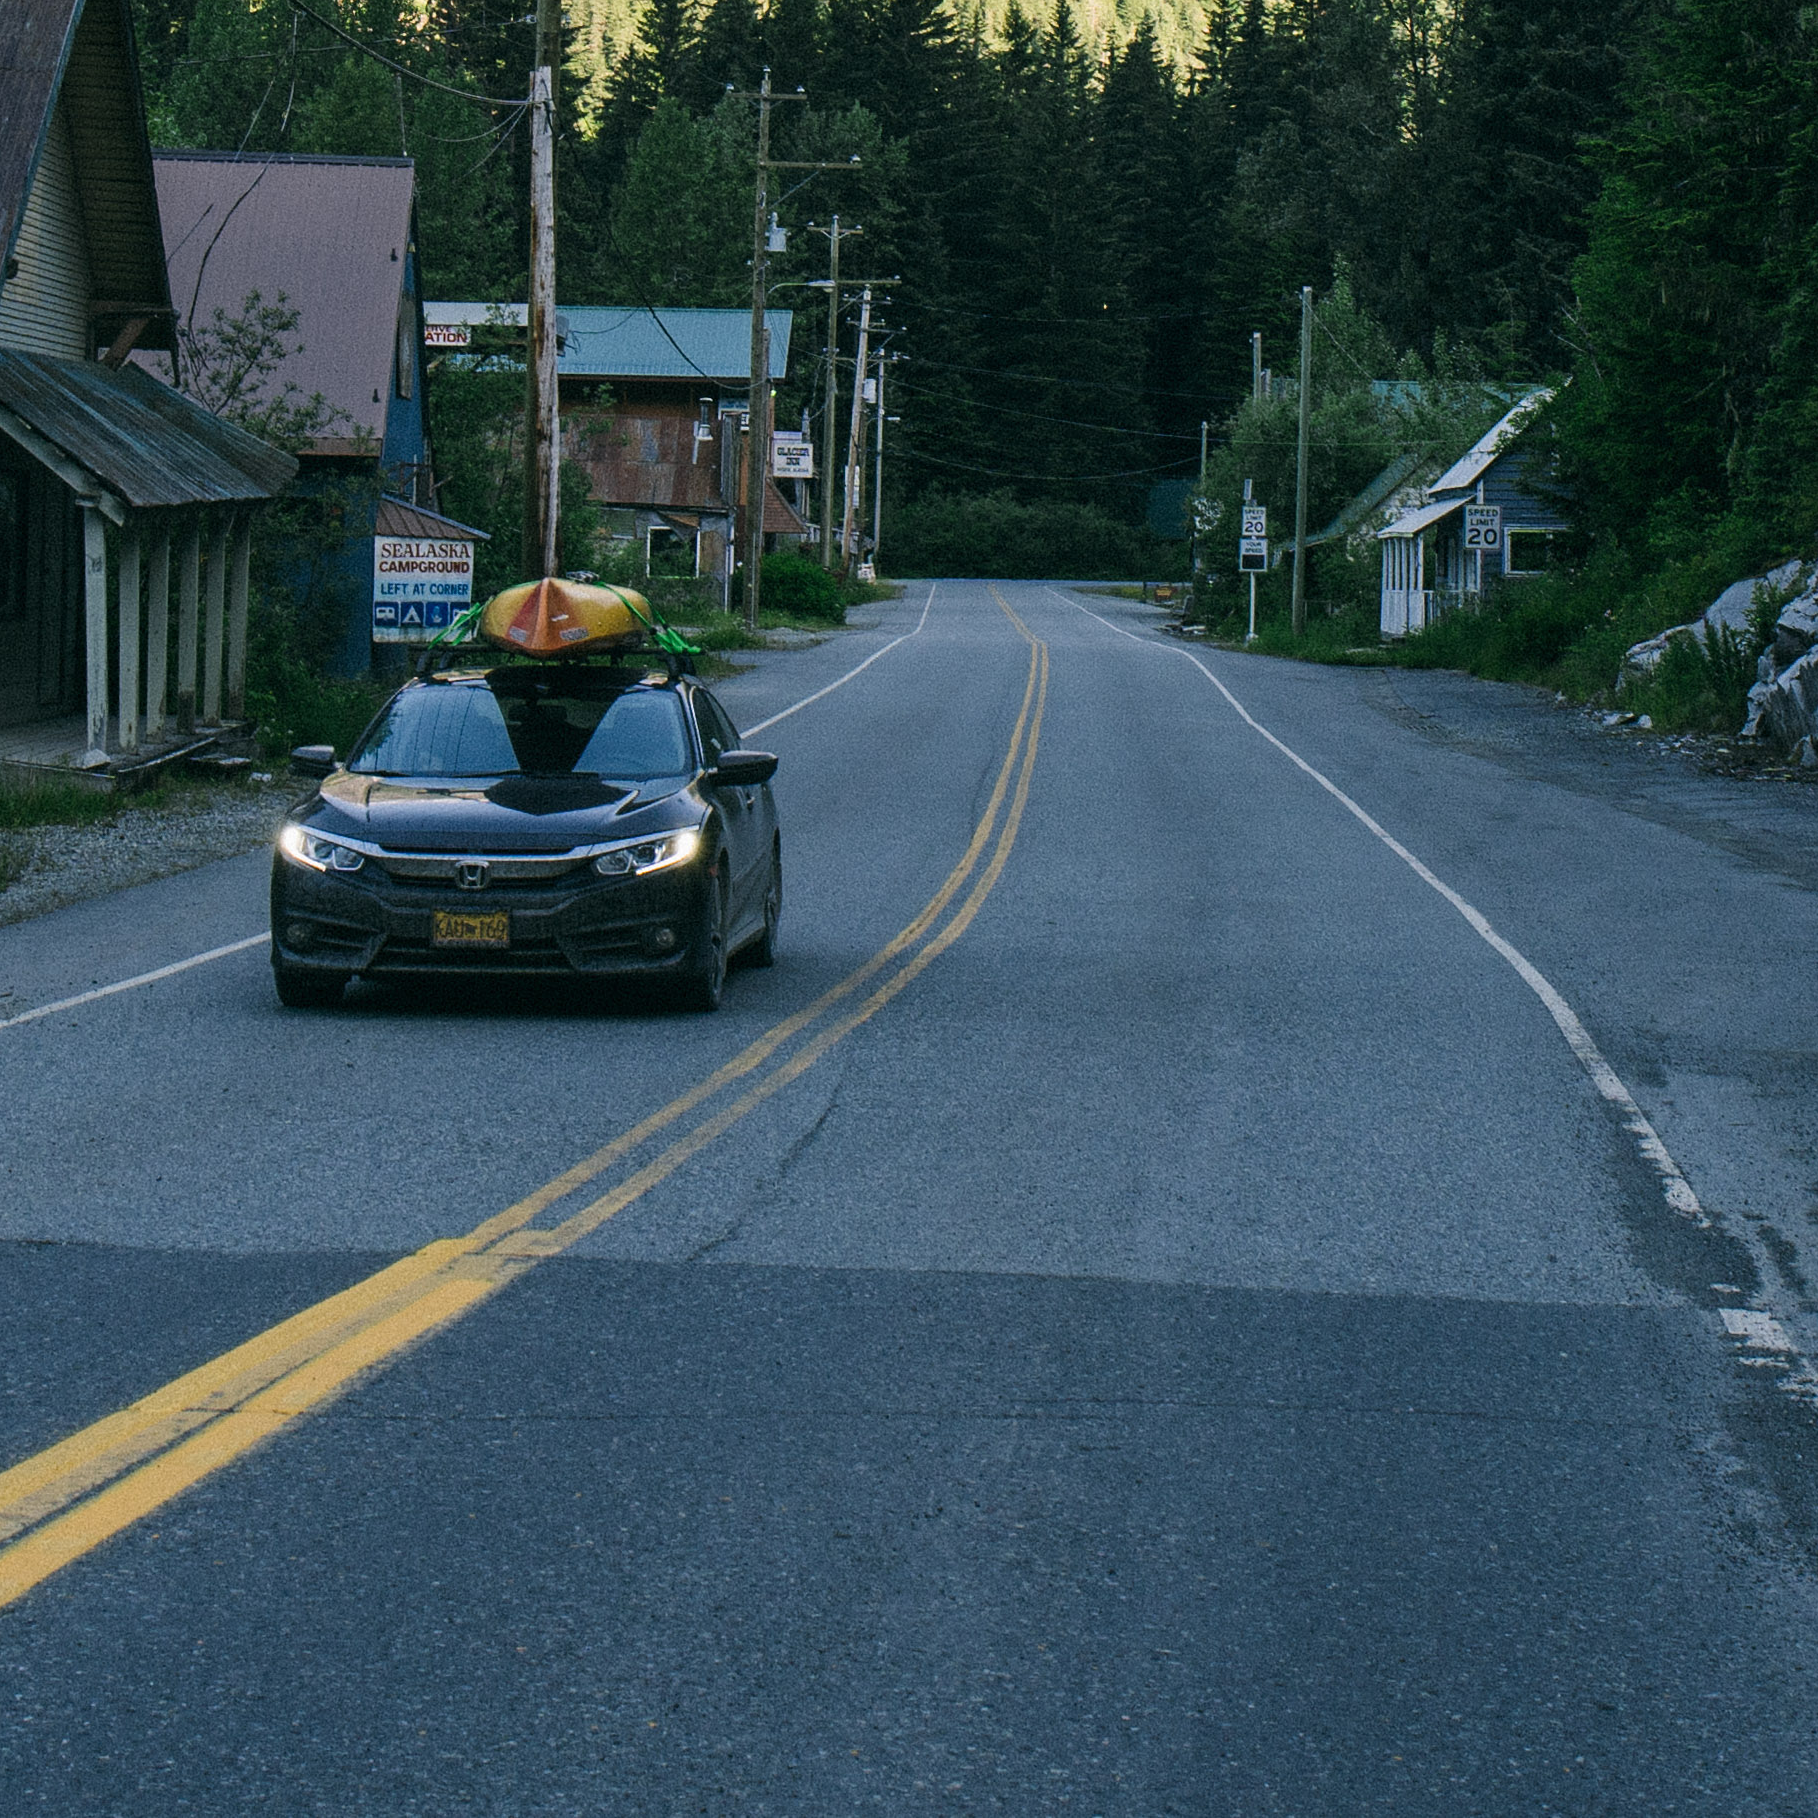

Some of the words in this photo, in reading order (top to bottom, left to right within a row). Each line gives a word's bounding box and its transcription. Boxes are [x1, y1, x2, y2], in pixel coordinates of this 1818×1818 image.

[425, 332, 468, 343] ATION
[1468, 508, 1499, 517] SPEED
[1245, 521, 1264, 533] 20
[1470, 518, 1495, 526] LIMIT
[1468, 527, 1498, 545] 20
[381, 543, 471, 559] SEALASKA
[379, 561, 471, 574] CAMPGROUND
[380, 583, 408, 595] LEFT
[413, 583, 426, 595] AT
[429, 583, 469, 596] CORNER
